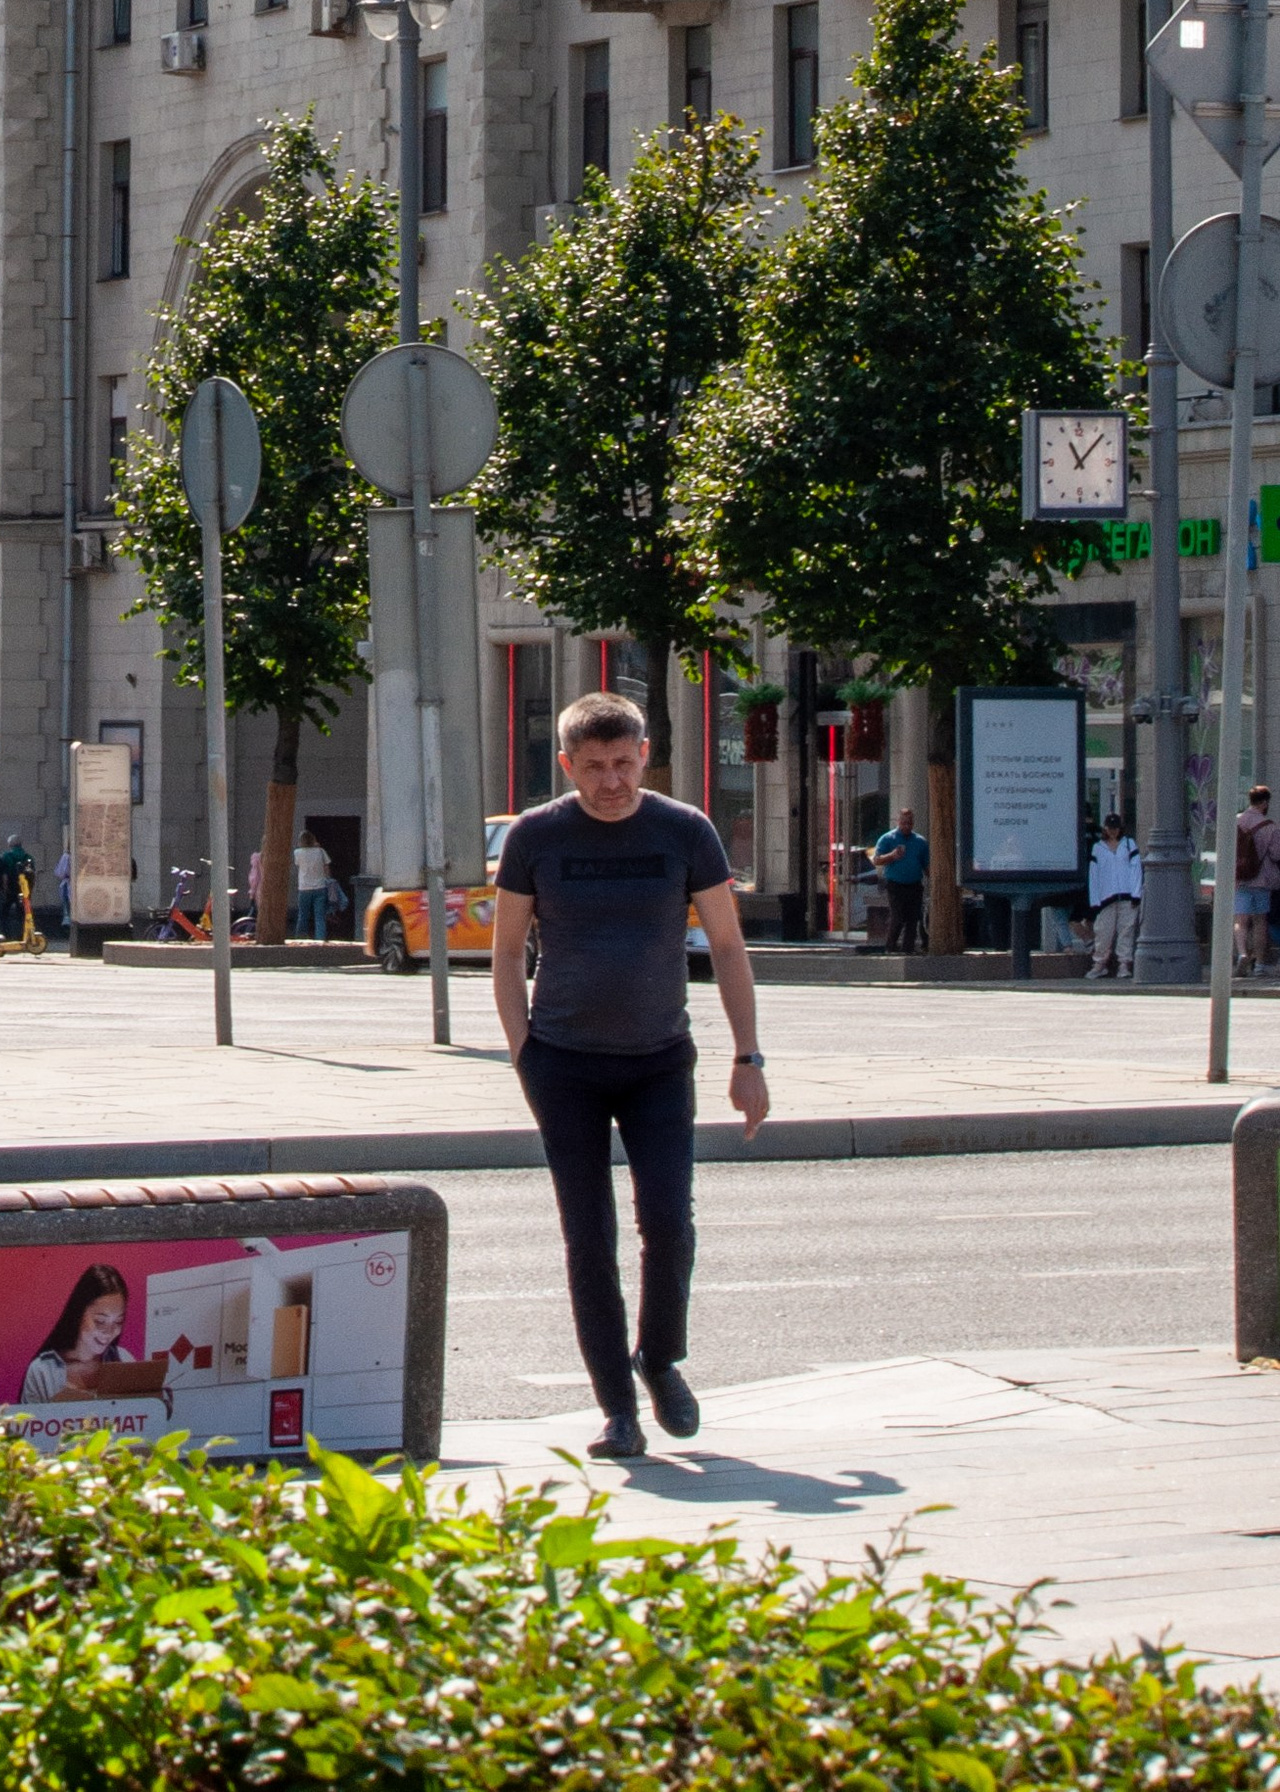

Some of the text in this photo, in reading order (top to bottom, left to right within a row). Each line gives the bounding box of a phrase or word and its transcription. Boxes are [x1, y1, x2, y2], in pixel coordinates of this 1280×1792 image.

[1074, 428, 1084, 437] 12
[1048, 458, 1055, 467] 9
[1104, 458, 1111, 467] 3
[1076, 487, 1083, 496] 6
[1087, 520, 1219, 560] ЕГАОН
[985, 771, 1065, 779] БЕЖАТЬ БОСИКОМ
[985, 786, 1053, 794] С КЛУБНИЧНЫМ
[993, 801, 1048, 810] ПЛОМБИРОМ
[369, 1261, 394, 1276] 16+
